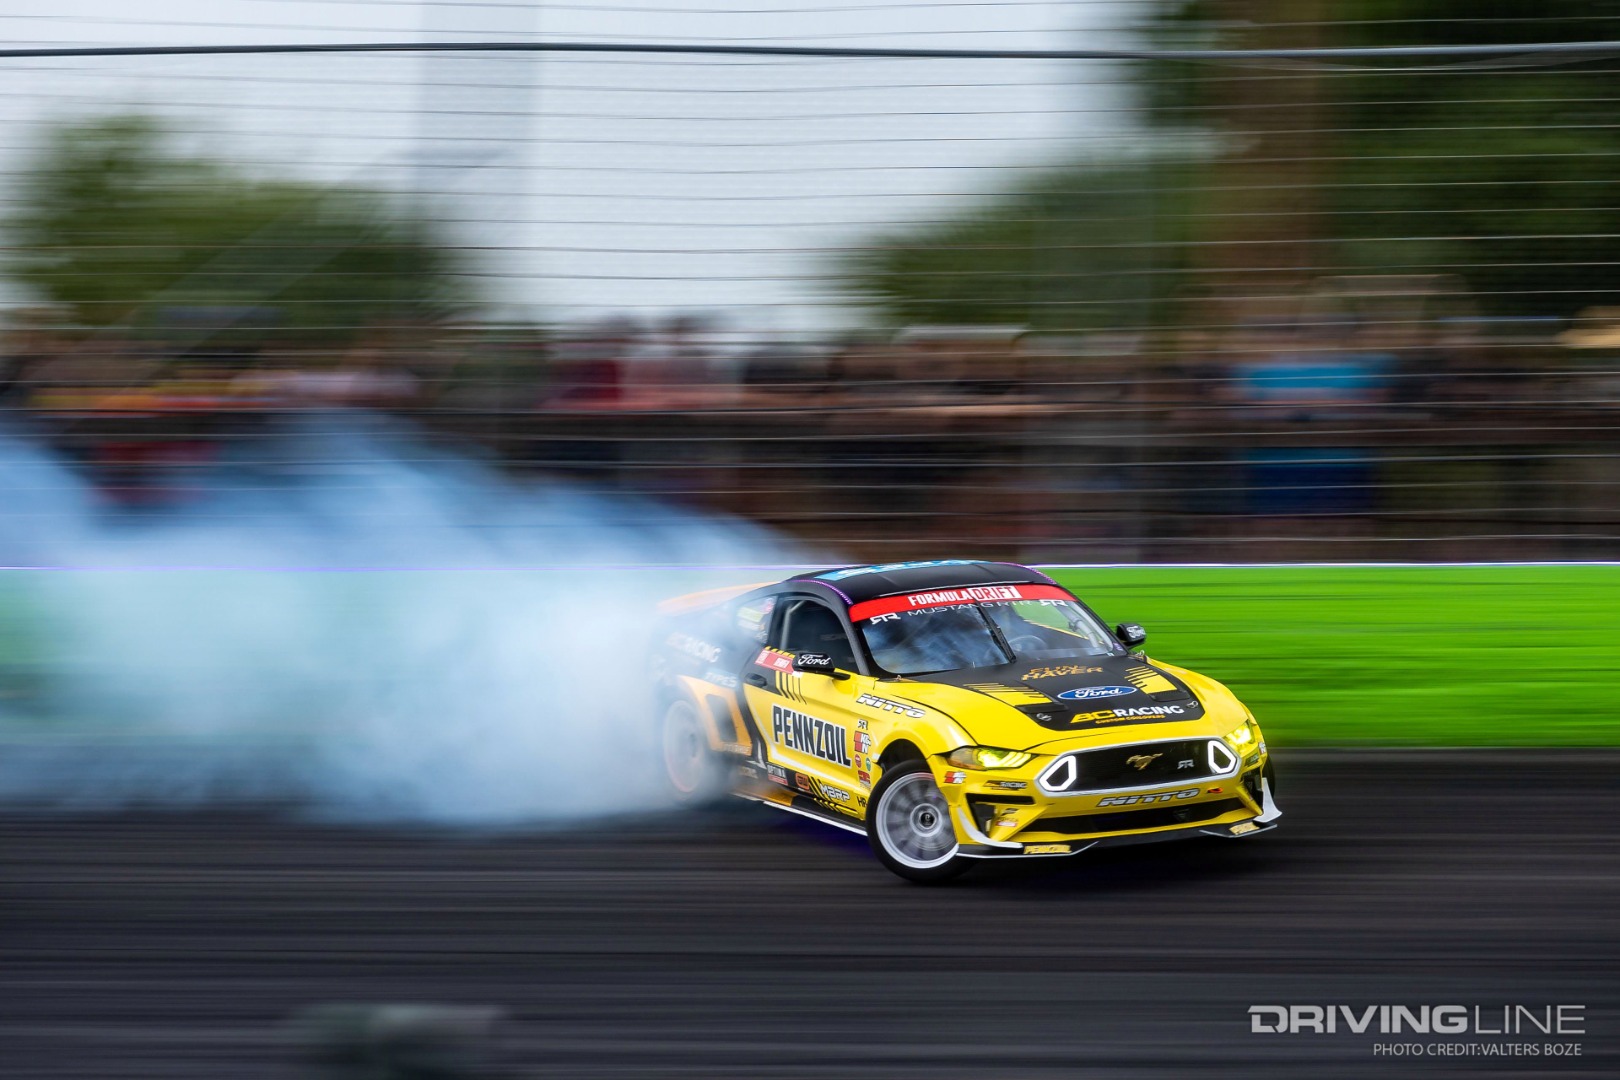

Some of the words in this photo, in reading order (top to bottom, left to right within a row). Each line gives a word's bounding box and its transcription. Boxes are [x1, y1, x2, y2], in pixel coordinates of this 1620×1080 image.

[908, 588, 974, 606] FORMULA
[971, 585, 1020, 600] DRIFT
[797, 654, 831, 666] Ford
[1075, 687, 1123, 699] Ford
[856, 693, 926, 718] NITTO
[773, 704, 852, 769] PENNZOIL
[819, 783, 850, 802] MBRP
[1096, 788, 1200, 808] NITTO
